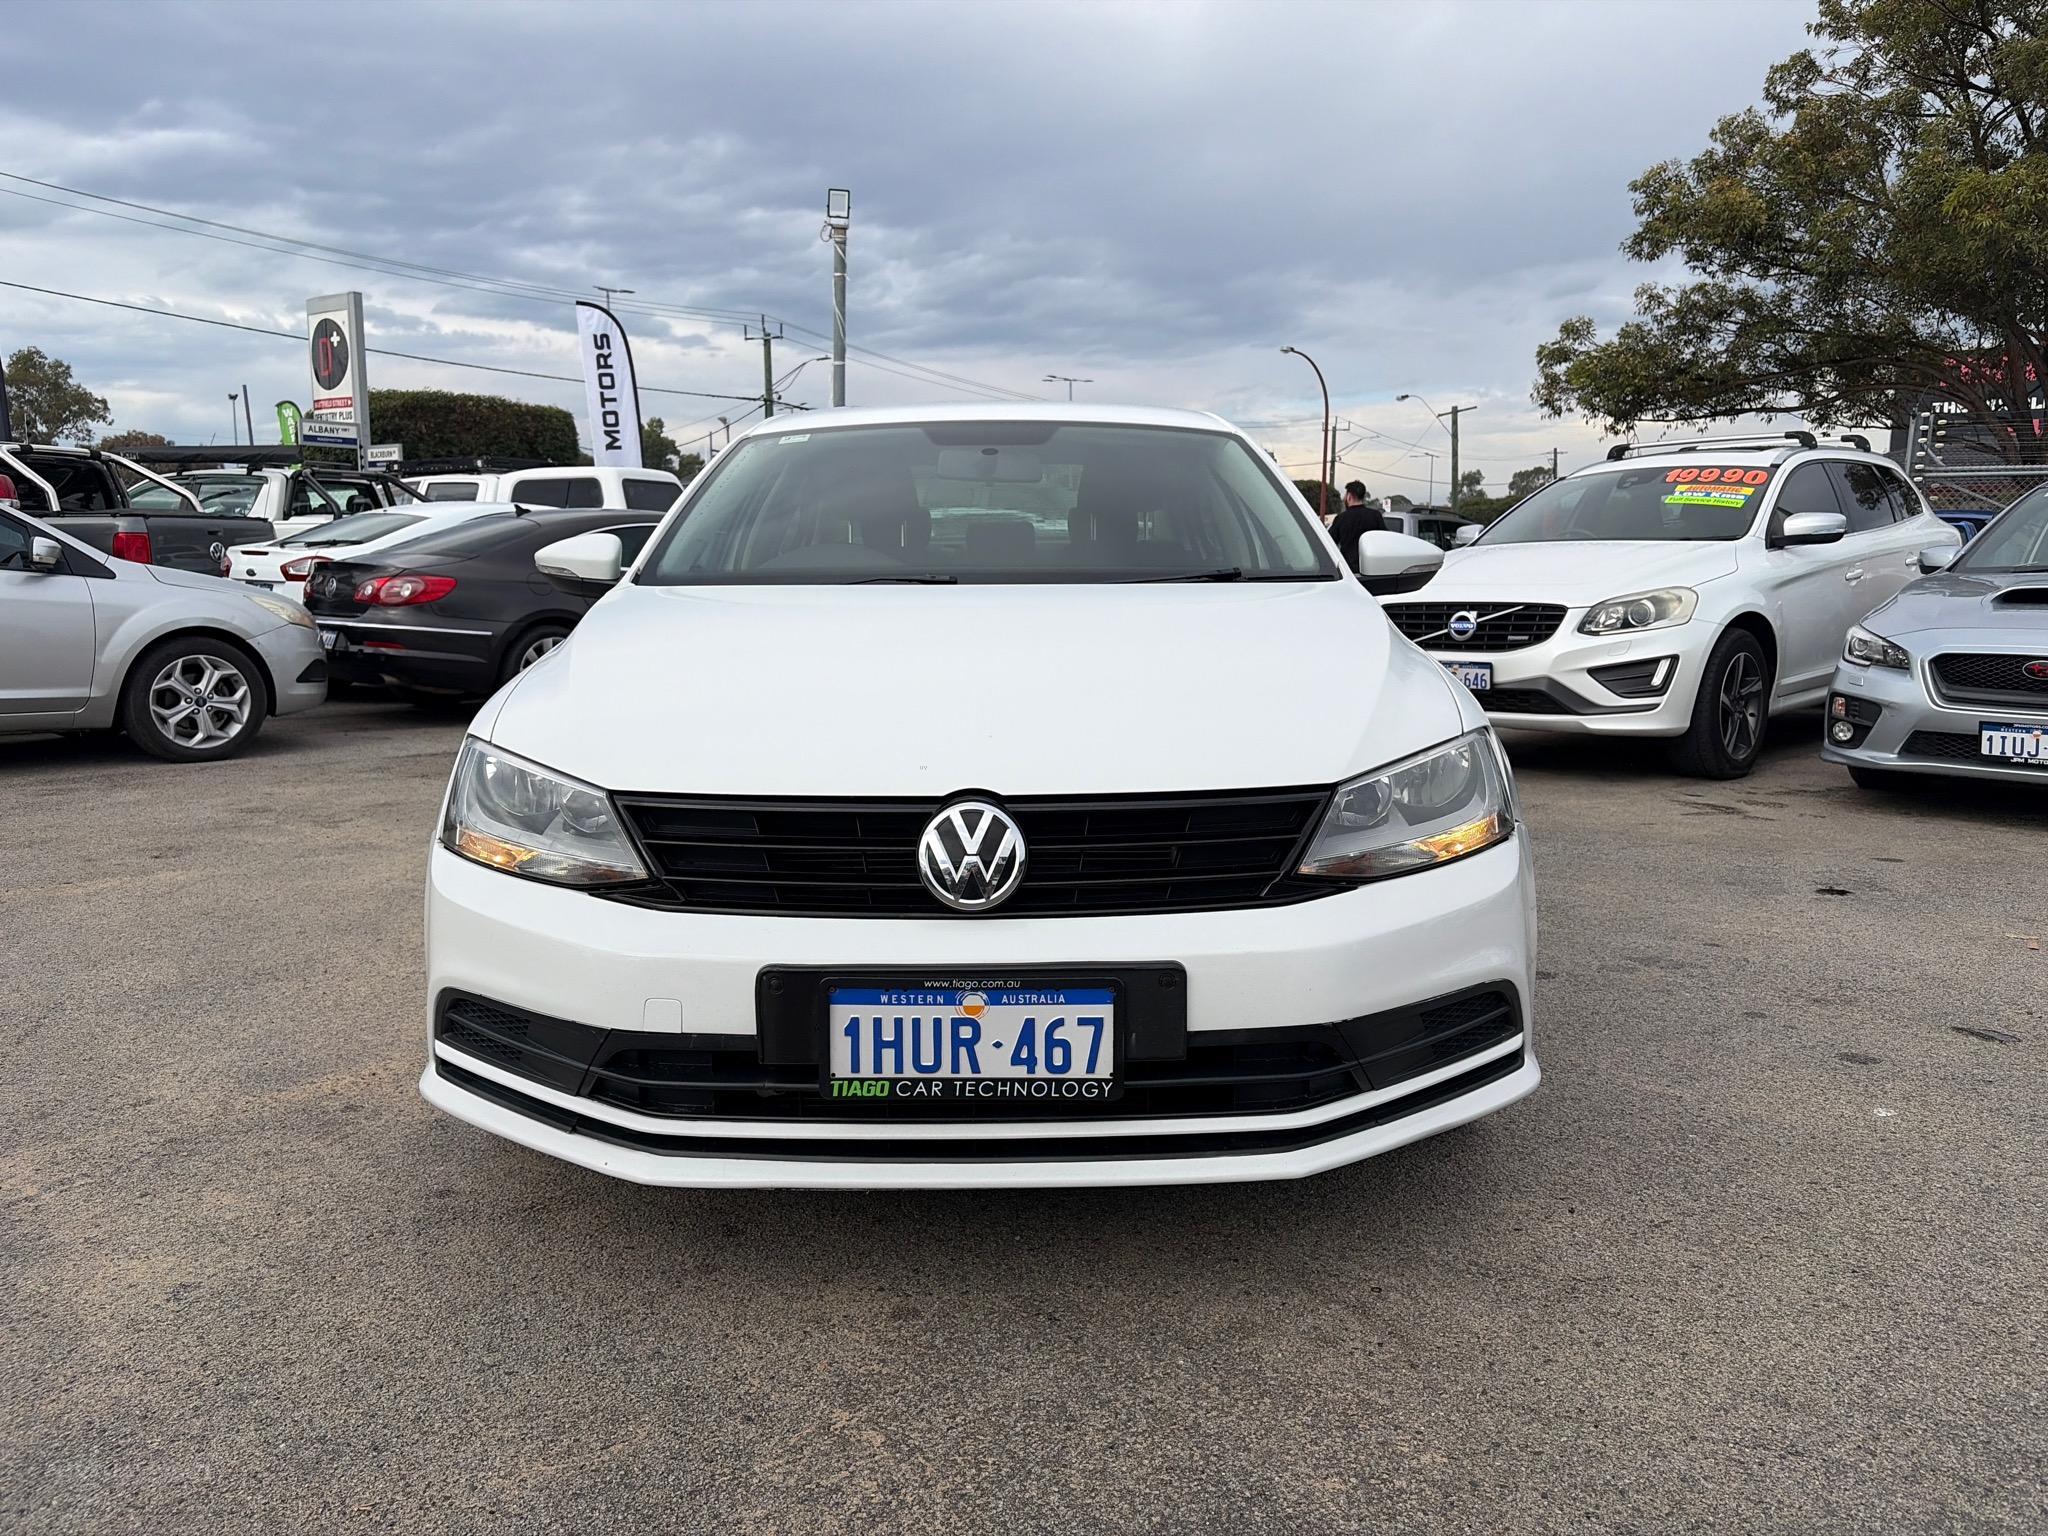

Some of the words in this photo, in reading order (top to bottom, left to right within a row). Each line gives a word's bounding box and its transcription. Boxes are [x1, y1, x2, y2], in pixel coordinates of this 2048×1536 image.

[593, 333, 622, 451] MOTORS
[339, 410, 353, 420] PLUS
[308, 424, 340, 435] ALBANY
[370, 450, 393, 458] BLACKBURN
[1665, 468, 1768, 485] 19990
[1685, 485, 1744, 493] AUTOMATIC
[924, 979, 1021, 989] www.tiago.com.au
[880, 994, 944, 1004] WESTERN
[1001, 994, 1066, 1004] AUSTRALIA
[830, 1080, 890, 1097] TIAGO
[896, 1080, 942, 1097] CAR
[954, 1080, 1114, 1098] TECHNOLOGY
